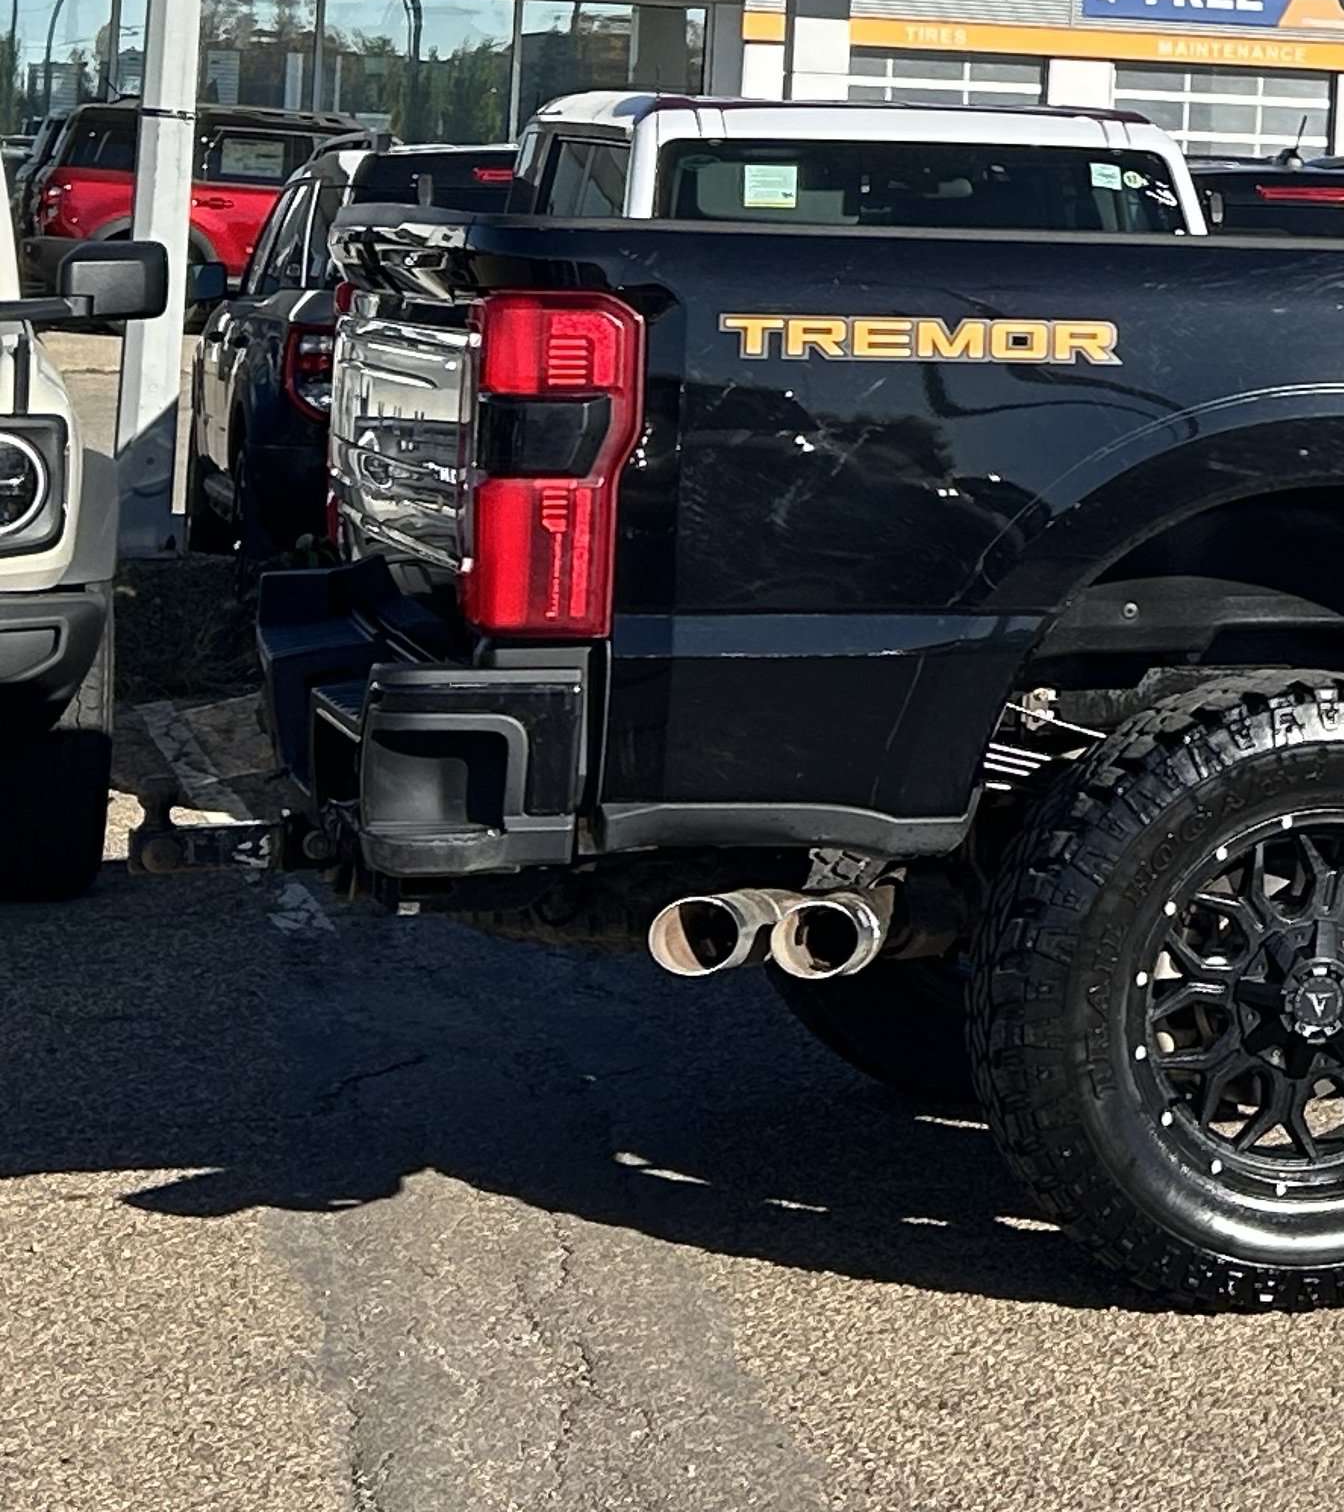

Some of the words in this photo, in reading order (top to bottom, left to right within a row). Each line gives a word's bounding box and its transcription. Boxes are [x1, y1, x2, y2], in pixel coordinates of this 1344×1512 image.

[905, 25, 967, 45] TIRES
[1157, 39, 1307, 63] MAINTENANCE
[719, 313, 1123, 365] TREMOR
